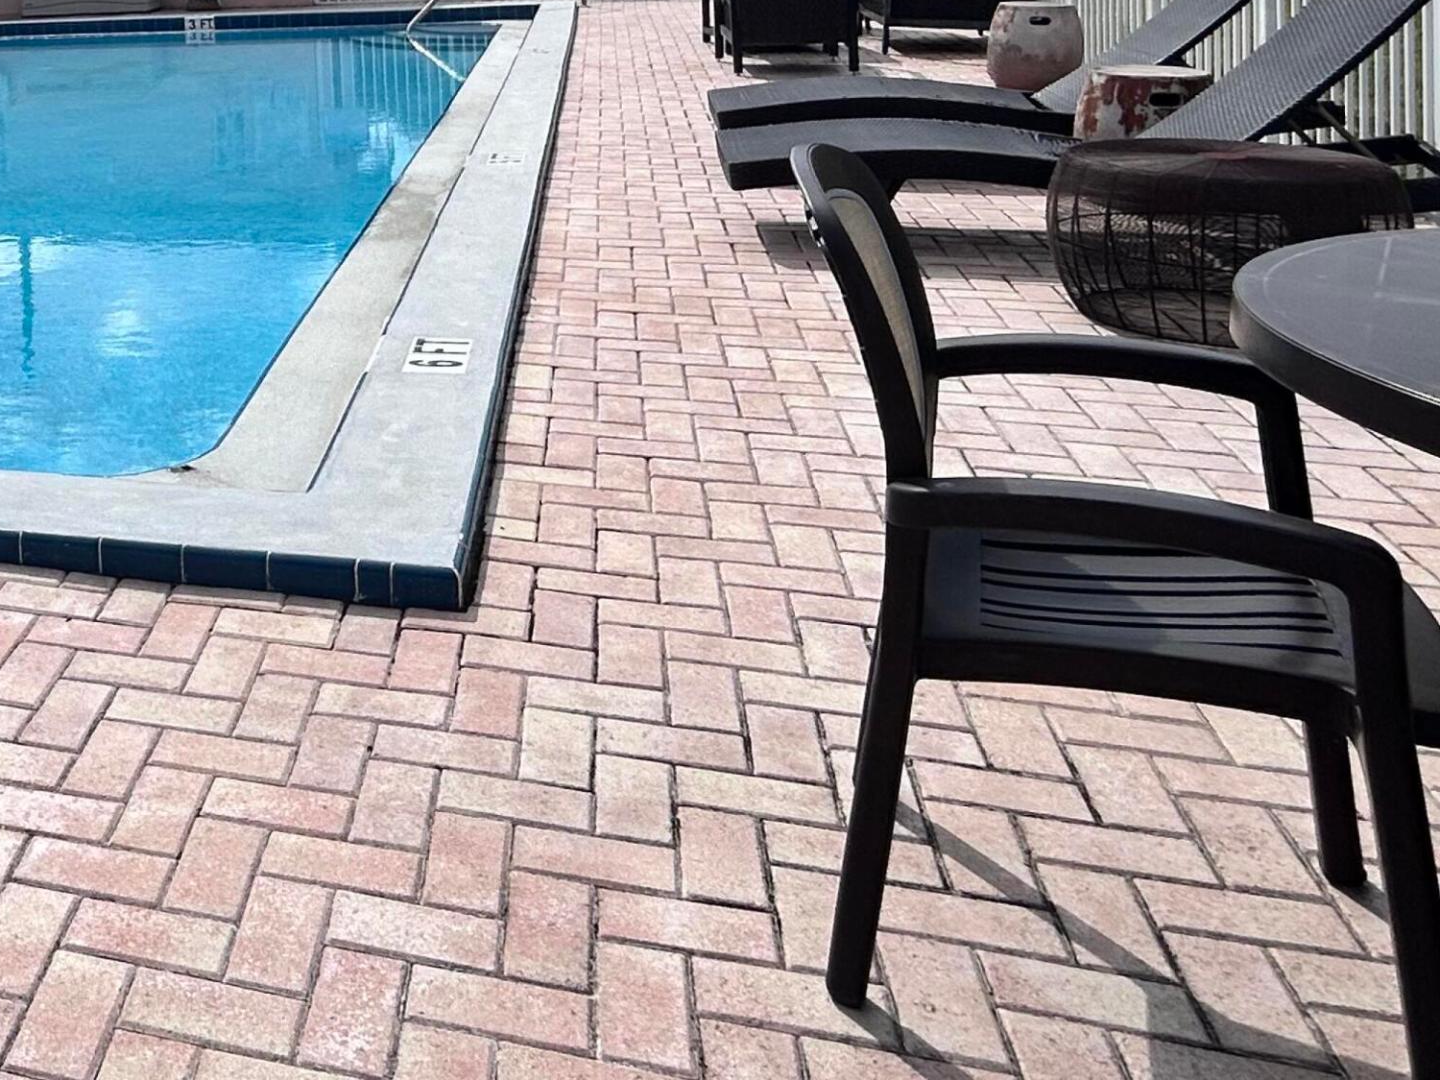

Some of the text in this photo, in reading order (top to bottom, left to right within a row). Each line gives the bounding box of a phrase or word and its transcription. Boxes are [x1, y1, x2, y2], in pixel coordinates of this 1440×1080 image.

[188, 19, 196, 30] 3
[408, 338, 470, 368] 6 FT
